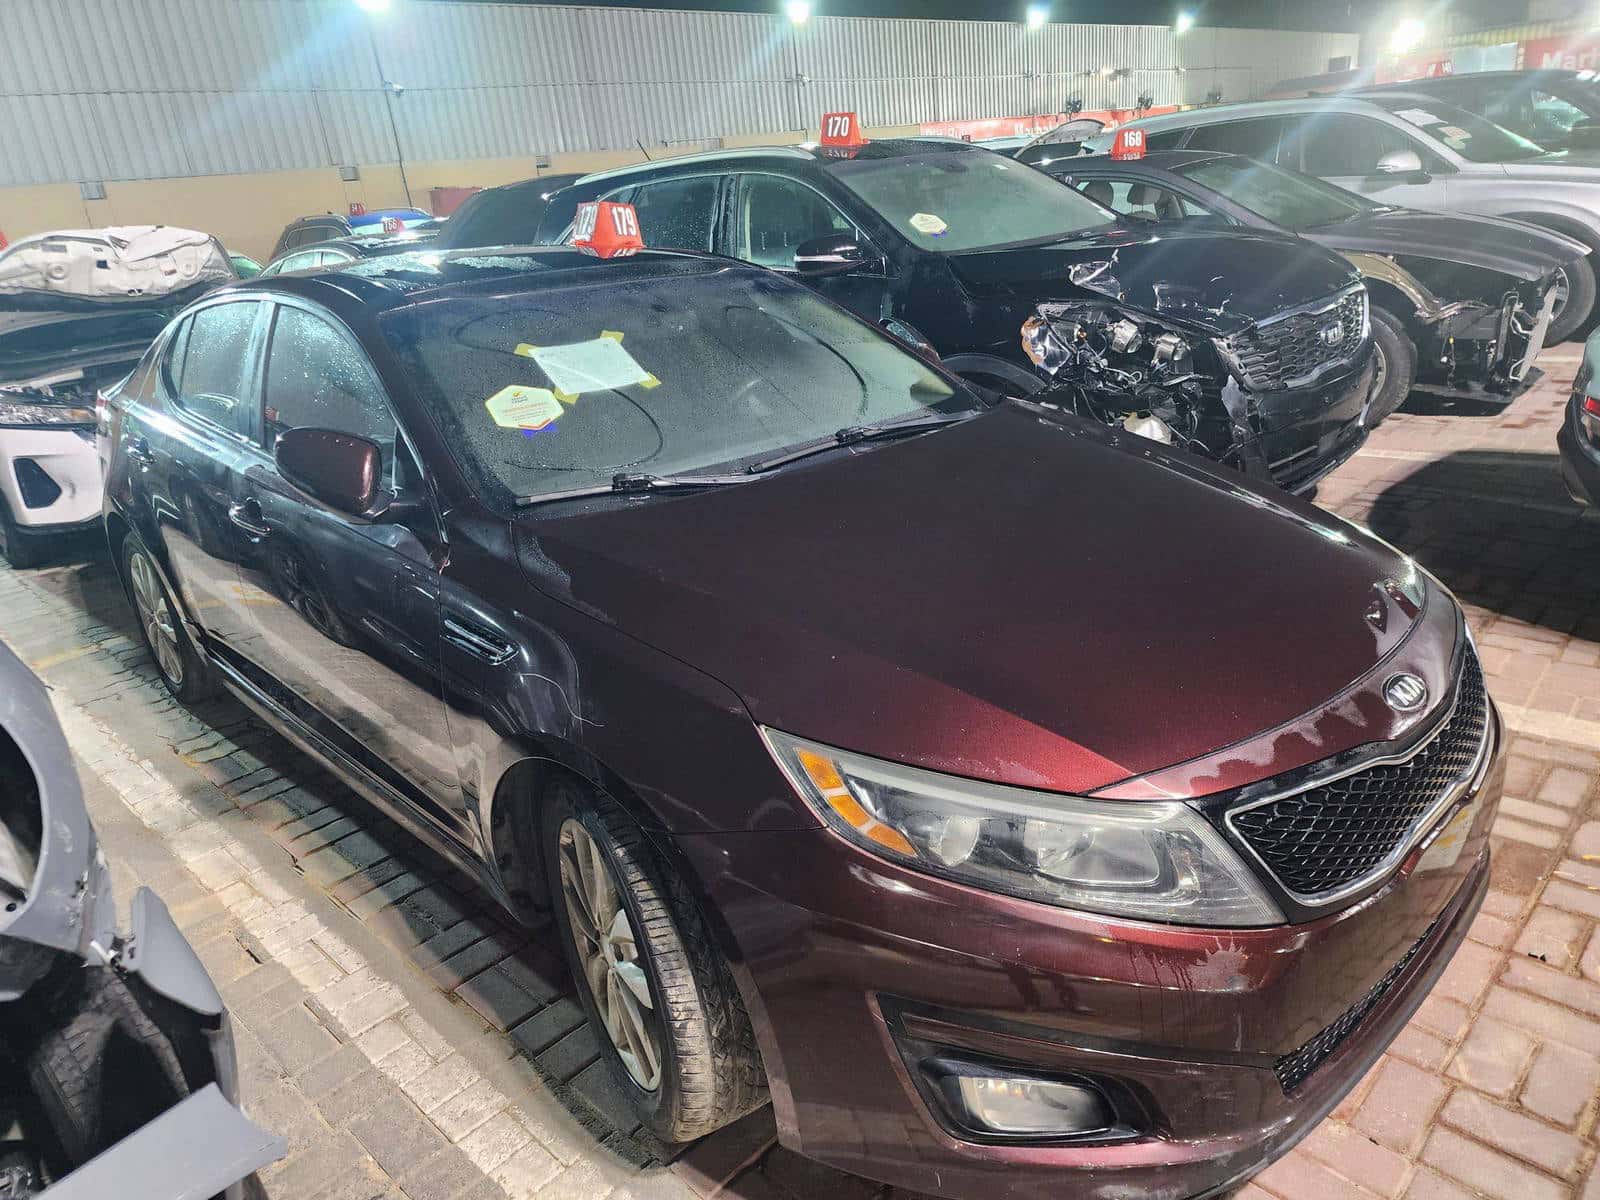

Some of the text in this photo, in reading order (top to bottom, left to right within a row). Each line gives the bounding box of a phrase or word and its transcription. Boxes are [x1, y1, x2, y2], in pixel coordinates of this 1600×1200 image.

[828, 116, 850, 138] 170
[1124, 130, 1142, 148] 168
[611, 206, 637, 236] 179
[1388, 676, 1424, 706] KIA
